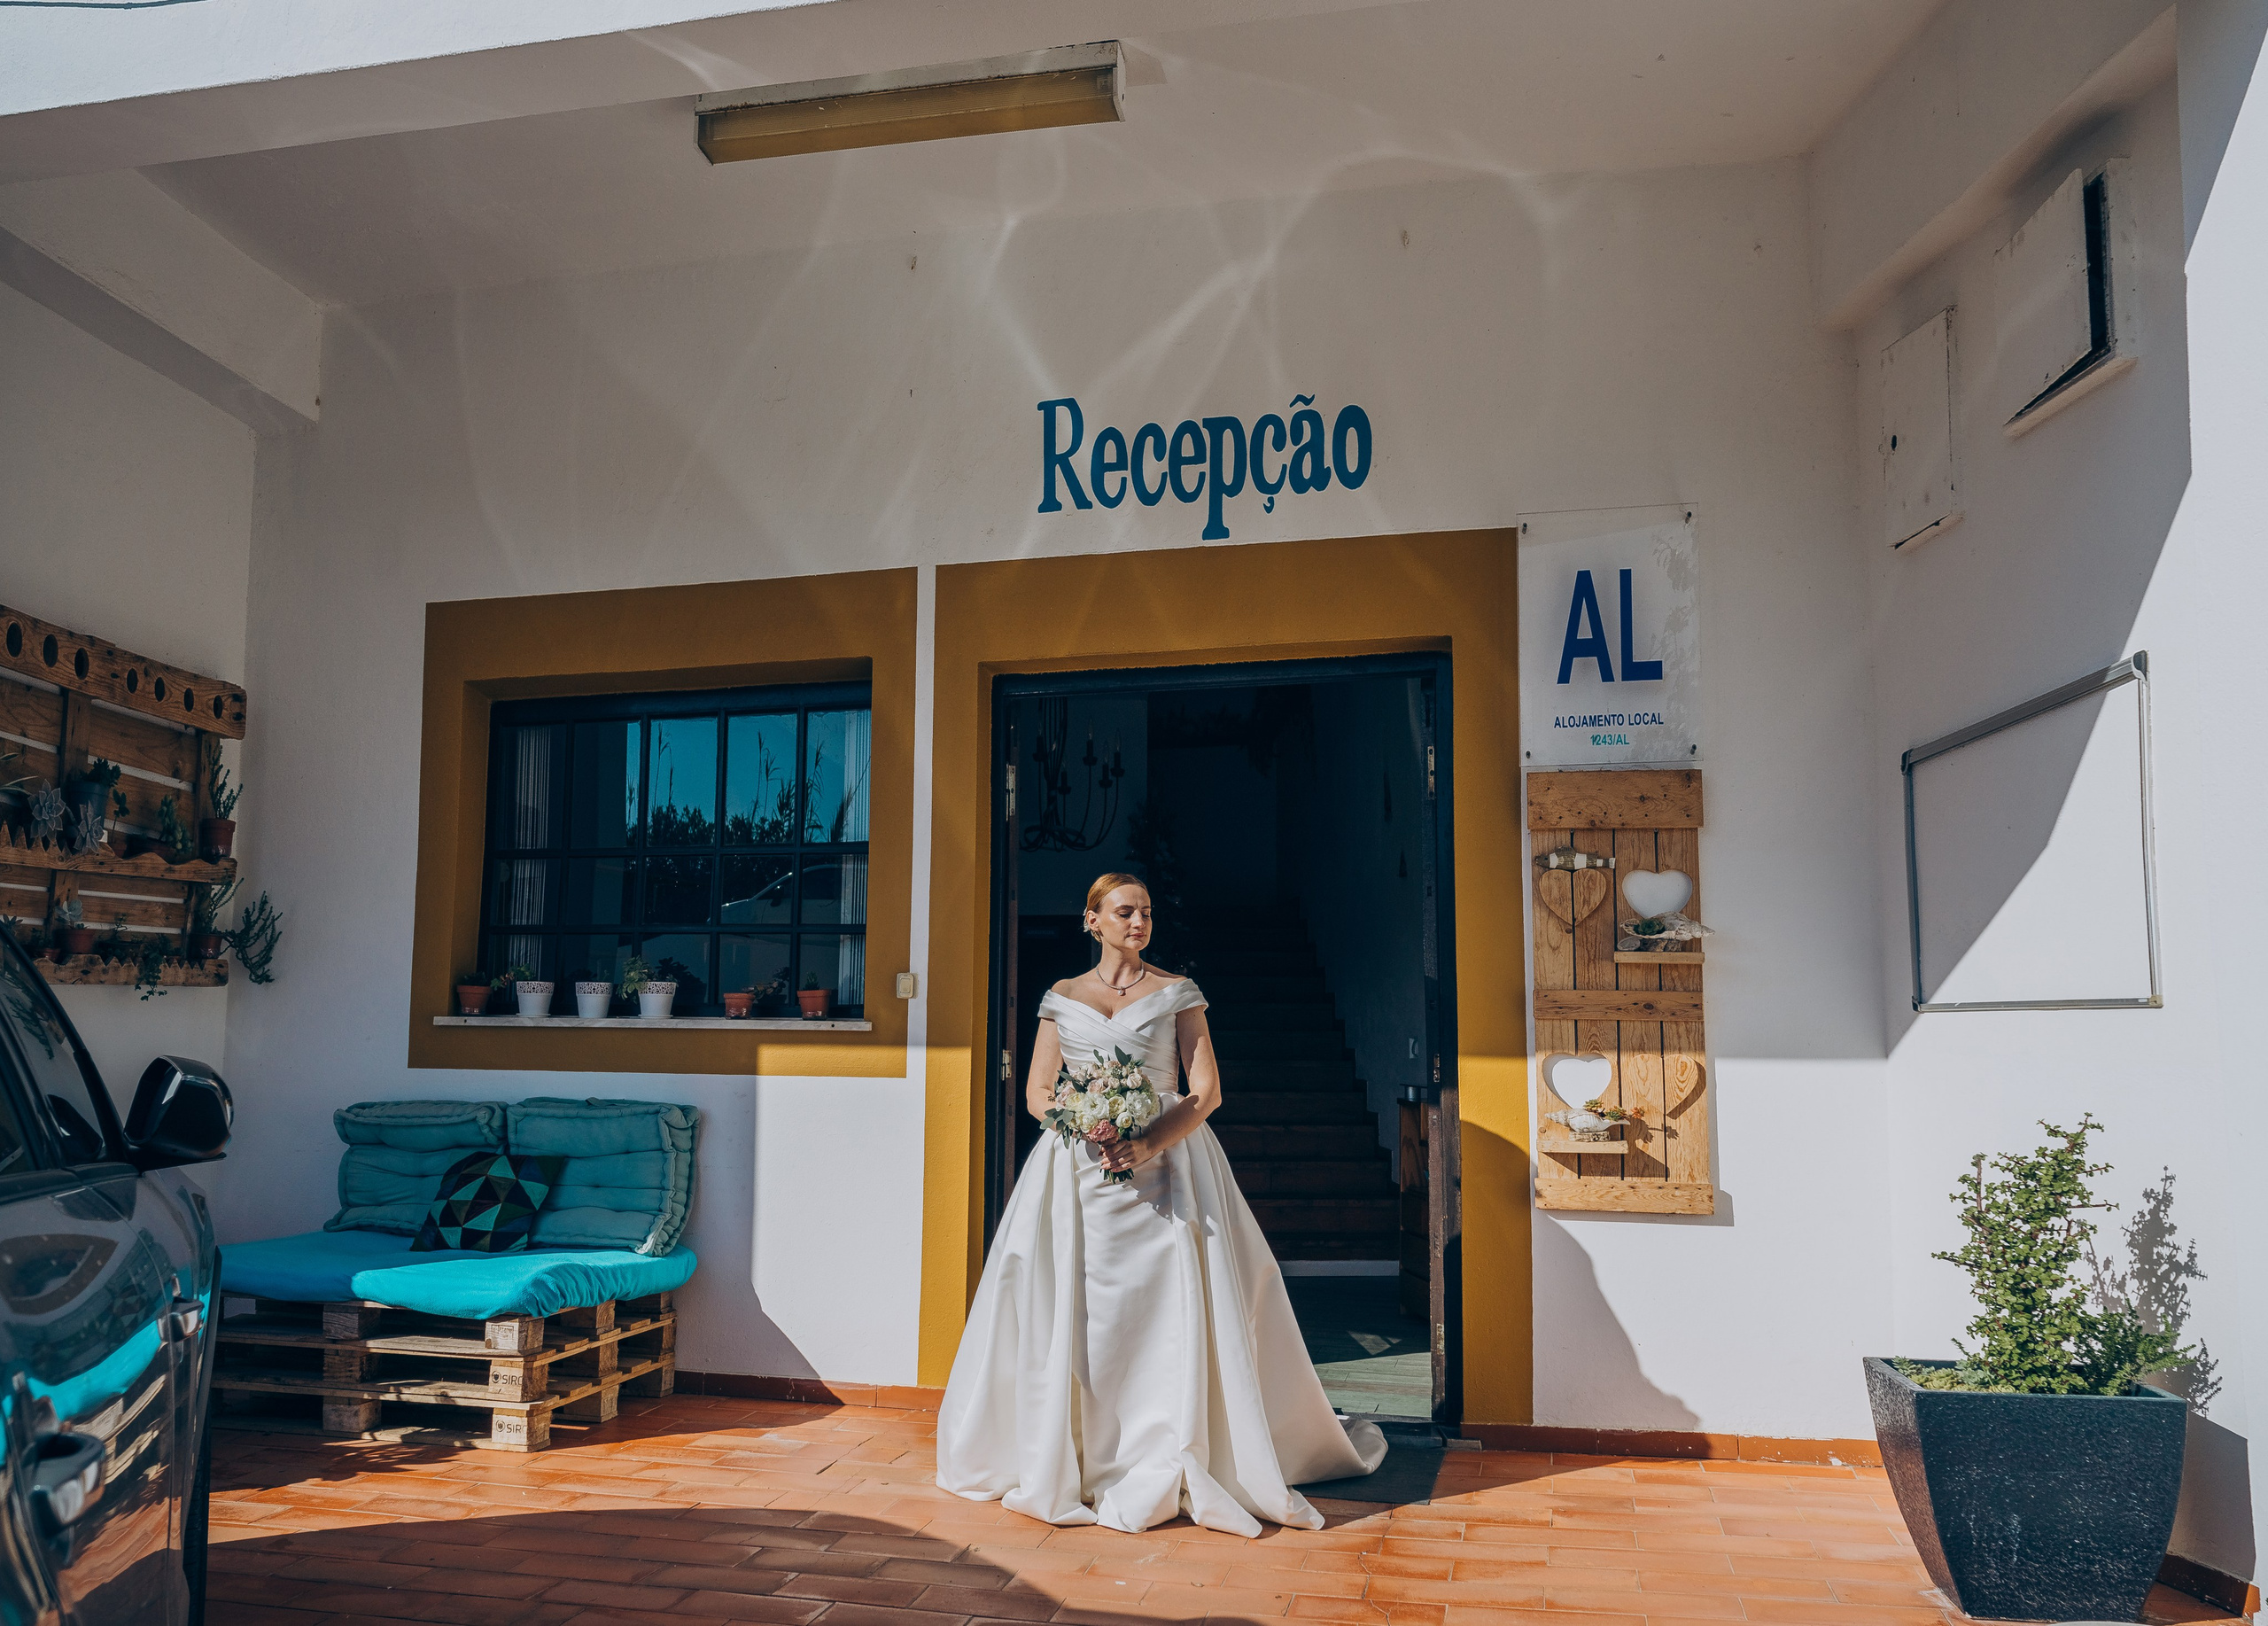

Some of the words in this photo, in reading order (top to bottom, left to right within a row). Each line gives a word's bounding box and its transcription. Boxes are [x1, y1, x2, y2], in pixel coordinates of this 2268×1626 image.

[1037, 393, 1372, 541] Recepção
[1557, 568, 1664, 685] AL
[1553, 713, 1625, 729] ALOJAMENTO
[1627, 712, 1665, 727] LOCAL
